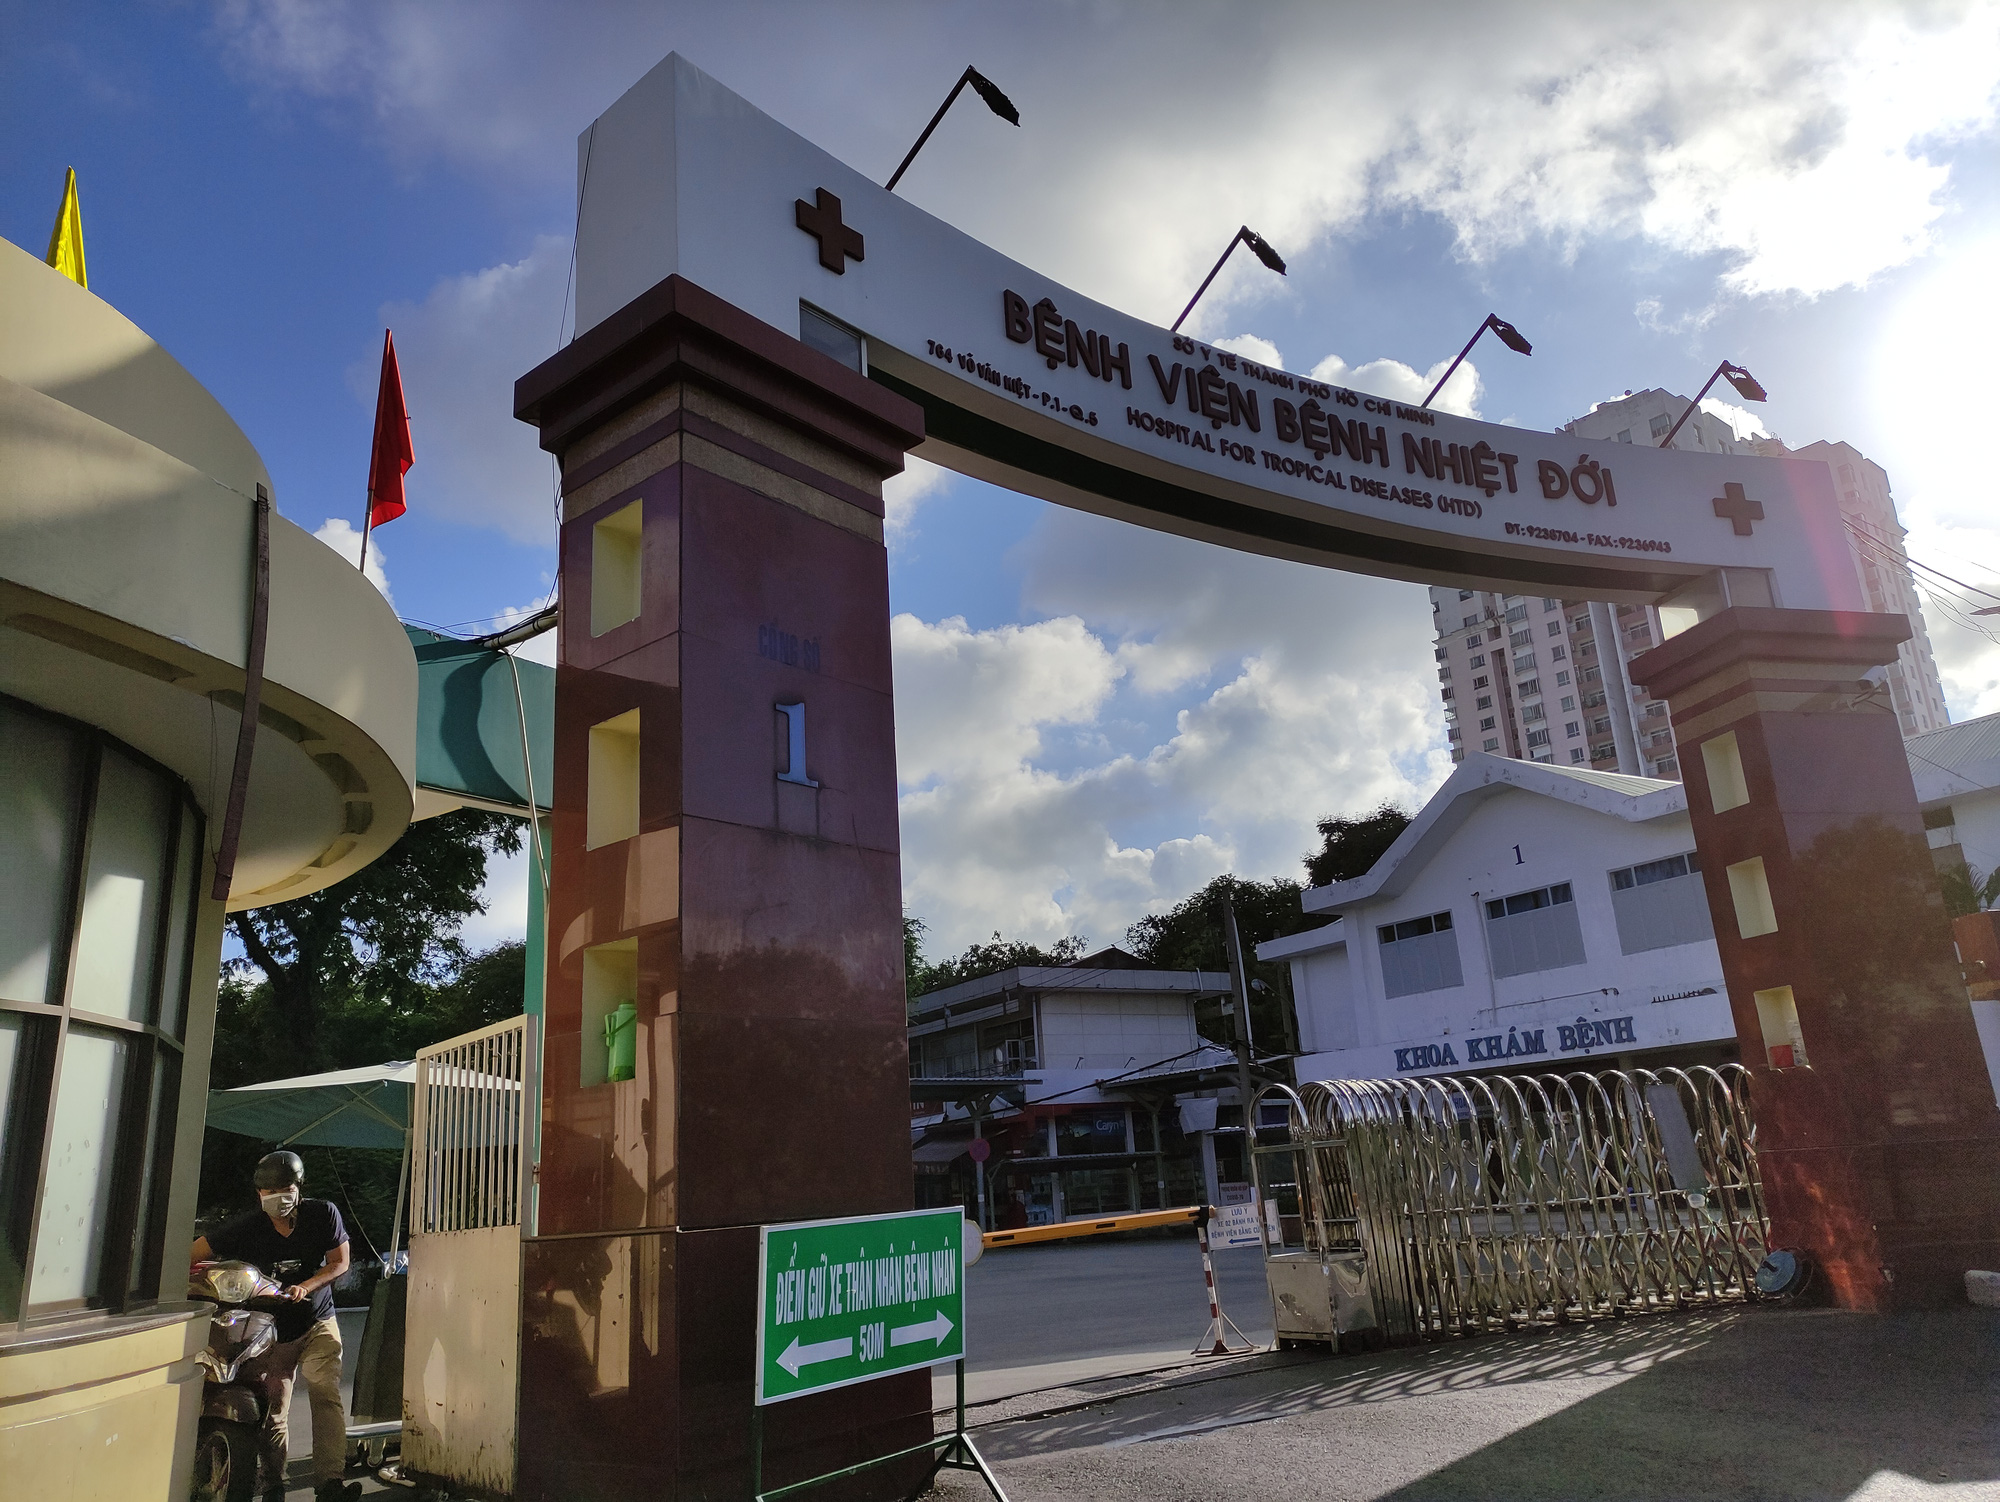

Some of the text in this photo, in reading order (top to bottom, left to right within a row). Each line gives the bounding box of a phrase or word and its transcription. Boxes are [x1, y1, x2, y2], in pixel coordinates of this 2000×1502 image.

[927, 339, 953, 363] 764
[957, 352, 976, 373] VÕ
[977, 363, 1001, 387] VĂN
[1003, 288, 1618, 507] BỆNH VIỆN BỆNH NHIỆT ĐỚI
[1200, 346, 1211, 361] Y
[1241, 361, 1294, 390] THÀNH
[1335, 388, 1359, 408] HỒ
[1363, 399, 1392, 417] CHÍ
[1396, 405, 1435, 426] MINH
[1127, 406, 1482, 519] HOSPITAL FOR TROPICAL DISEASES (HTD)
[774, 702, 819, 788] 1
[1512, 844, 1525, 866] 1
[1394, 1016, 1636, 1072] KHOA KHÁM BỆNH
[776, 1241, 805, 1325] ĐIỂM
[829, 1263, 843, 1316] XE
[846, 1247, 873, 1313] THÂN
[875, 1243, 902, 1308] NHÂN
[904, 1240, 929, 1312] BỆNH
[932, 1236, 956, 1298] NHÂN
[859, 1322, 885, 1362] 50M
